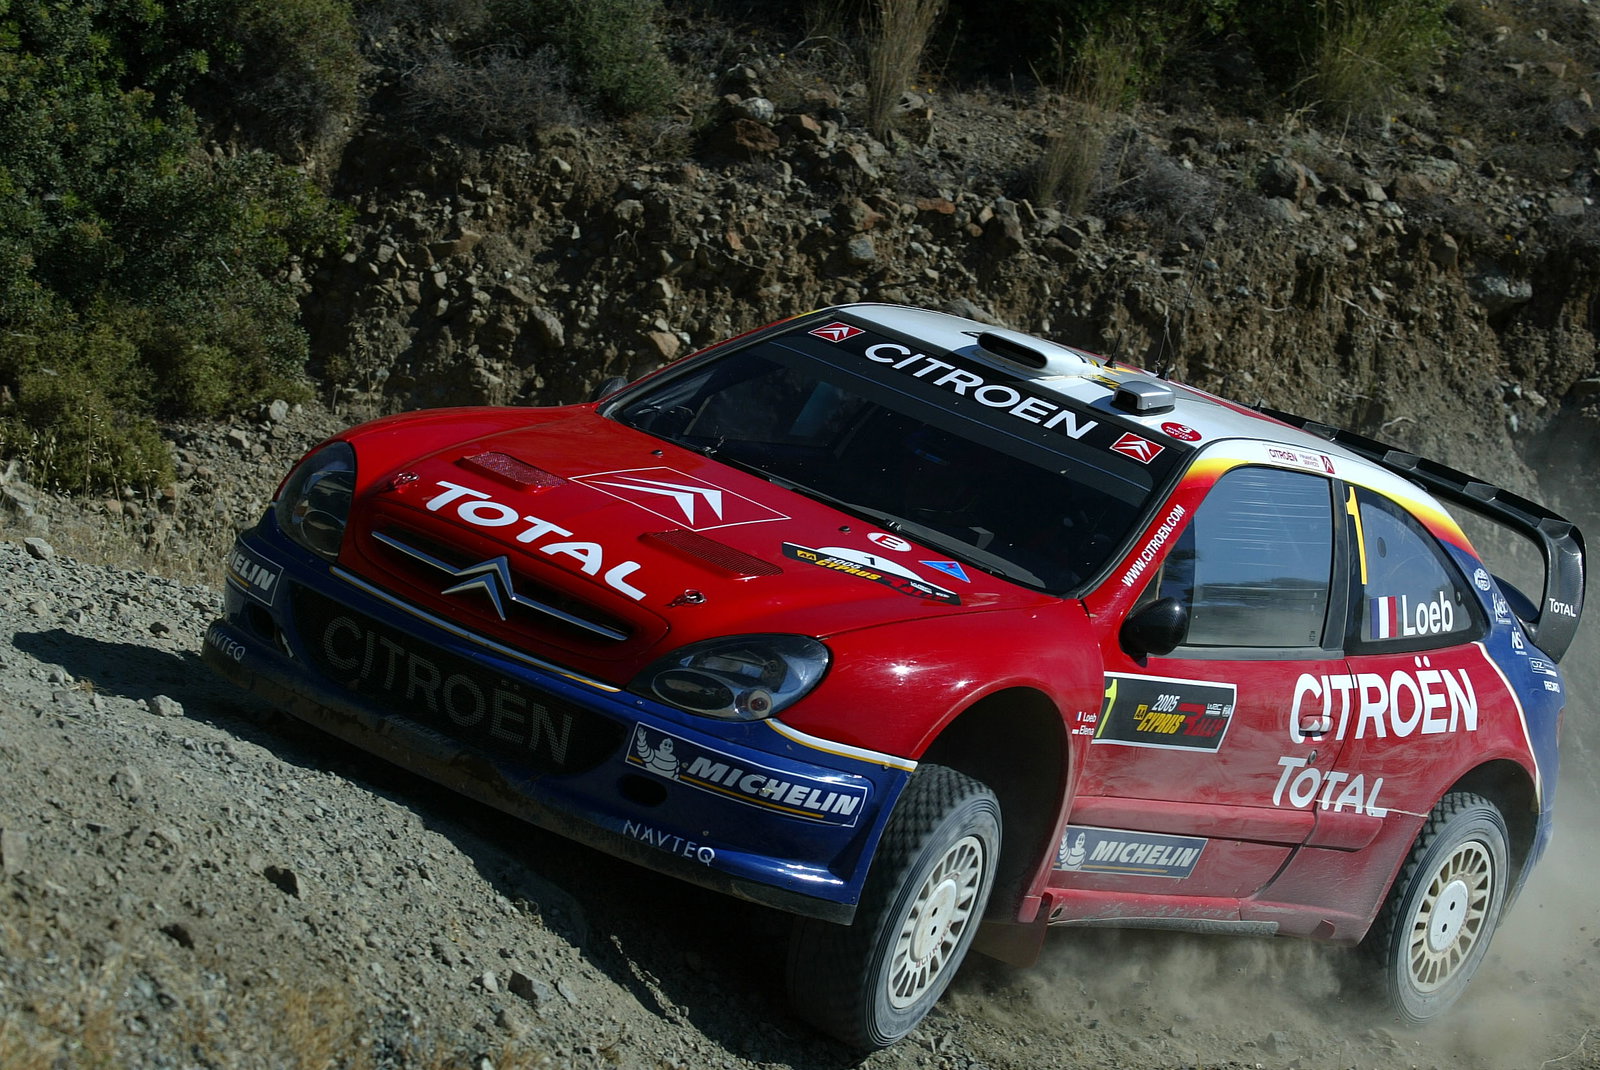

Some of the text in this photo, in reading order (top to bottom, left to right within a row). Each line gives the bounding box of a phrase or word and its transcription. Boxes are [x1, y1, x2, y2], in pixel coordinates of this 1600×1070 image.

[865, 343, 1099, 440] CITROEN
[426, 480, 647, 601] TOTAL
[864, 556, 876, 566] 1
[1121, 504, 1186, 587] WWW.CITROEN.COM
[1345, 486, 1368, 585] 1
[815, 559, 882, 581] CYPRUS
[824, 557, 863, 570] 2005
[1402, 590, 1454, 637] Loeb
[1548, 598, 1577, 618] TOTAL
[323, 615, 573, 766] CITROËN
[1094, 679, 1118, 739] 1
[1151, 694, 1180, 713] 2005
[1289, 656, 1478, 744] CITROËN
[1137, 712, 1186, 735] CYPRUS
[686, 755, 861, 816] MICHELIN
[1272, 756, 1388, 817] TOTAL
[623, 819, 716, 868] NAVTEQ
[1089, 840, 1200, 868] MICHELIN
